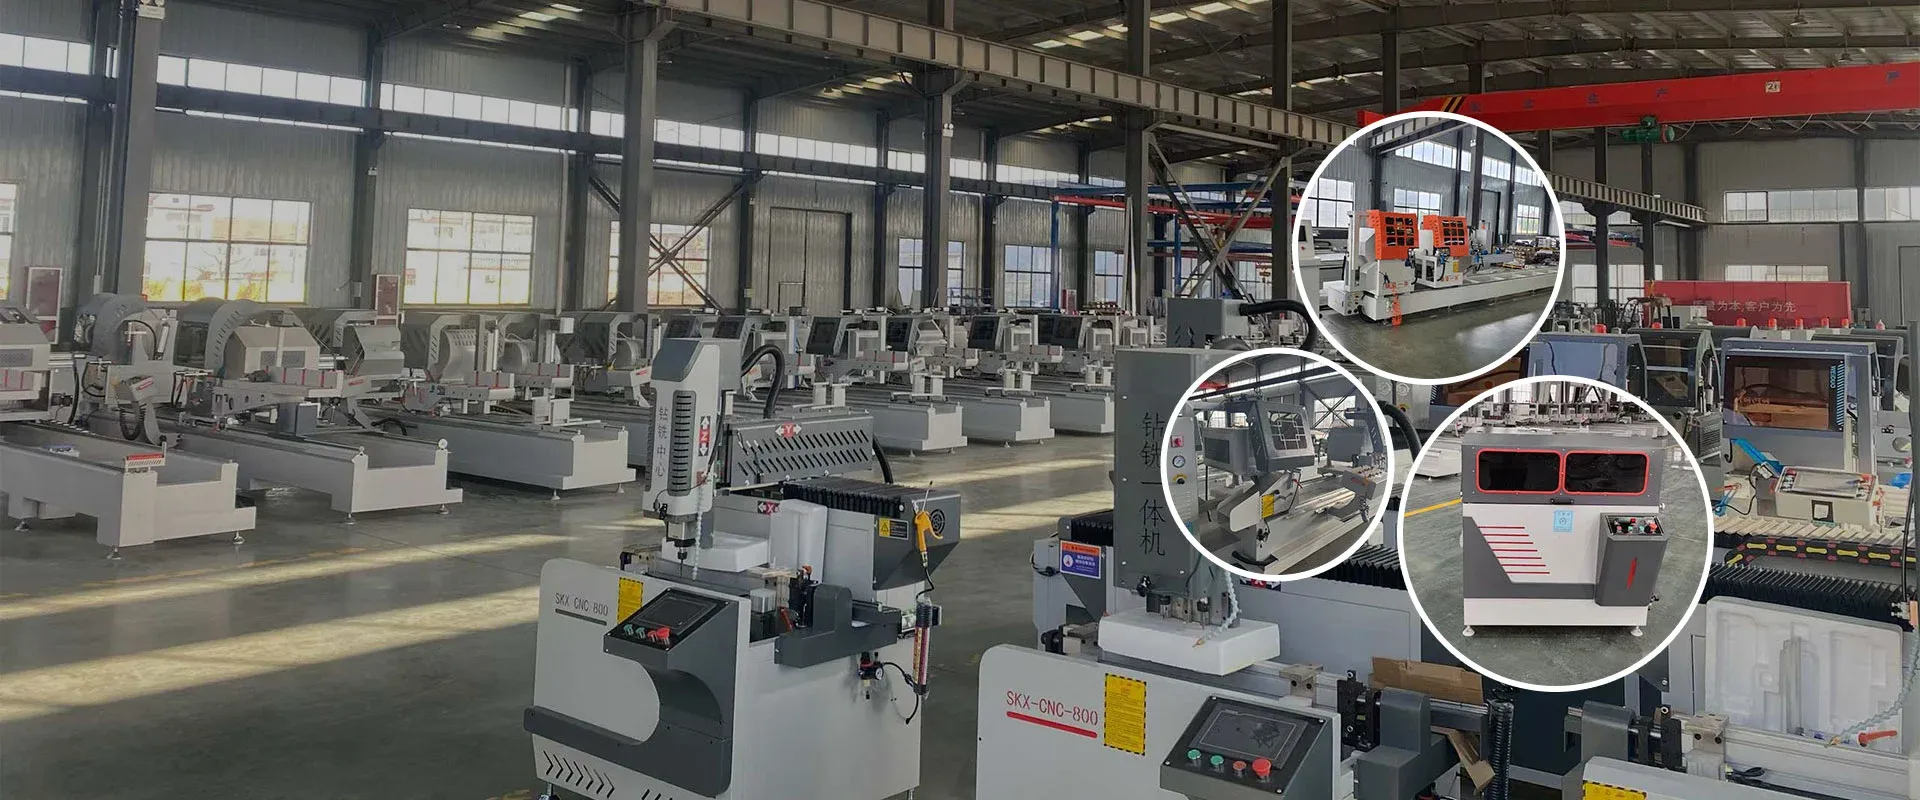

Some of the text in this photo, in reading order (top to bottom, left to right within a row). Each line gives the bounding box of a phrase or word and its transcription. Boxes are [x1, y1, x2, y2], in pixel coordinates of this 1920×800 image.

[655, 406, 668, 477] 钻铣中心
[1139, 412, 1166, 556] 钻铣一体机
[555, 592, 609, 617] SKX CNC 800
[1006, 690, 1098, 726] SKX-CNC-800
